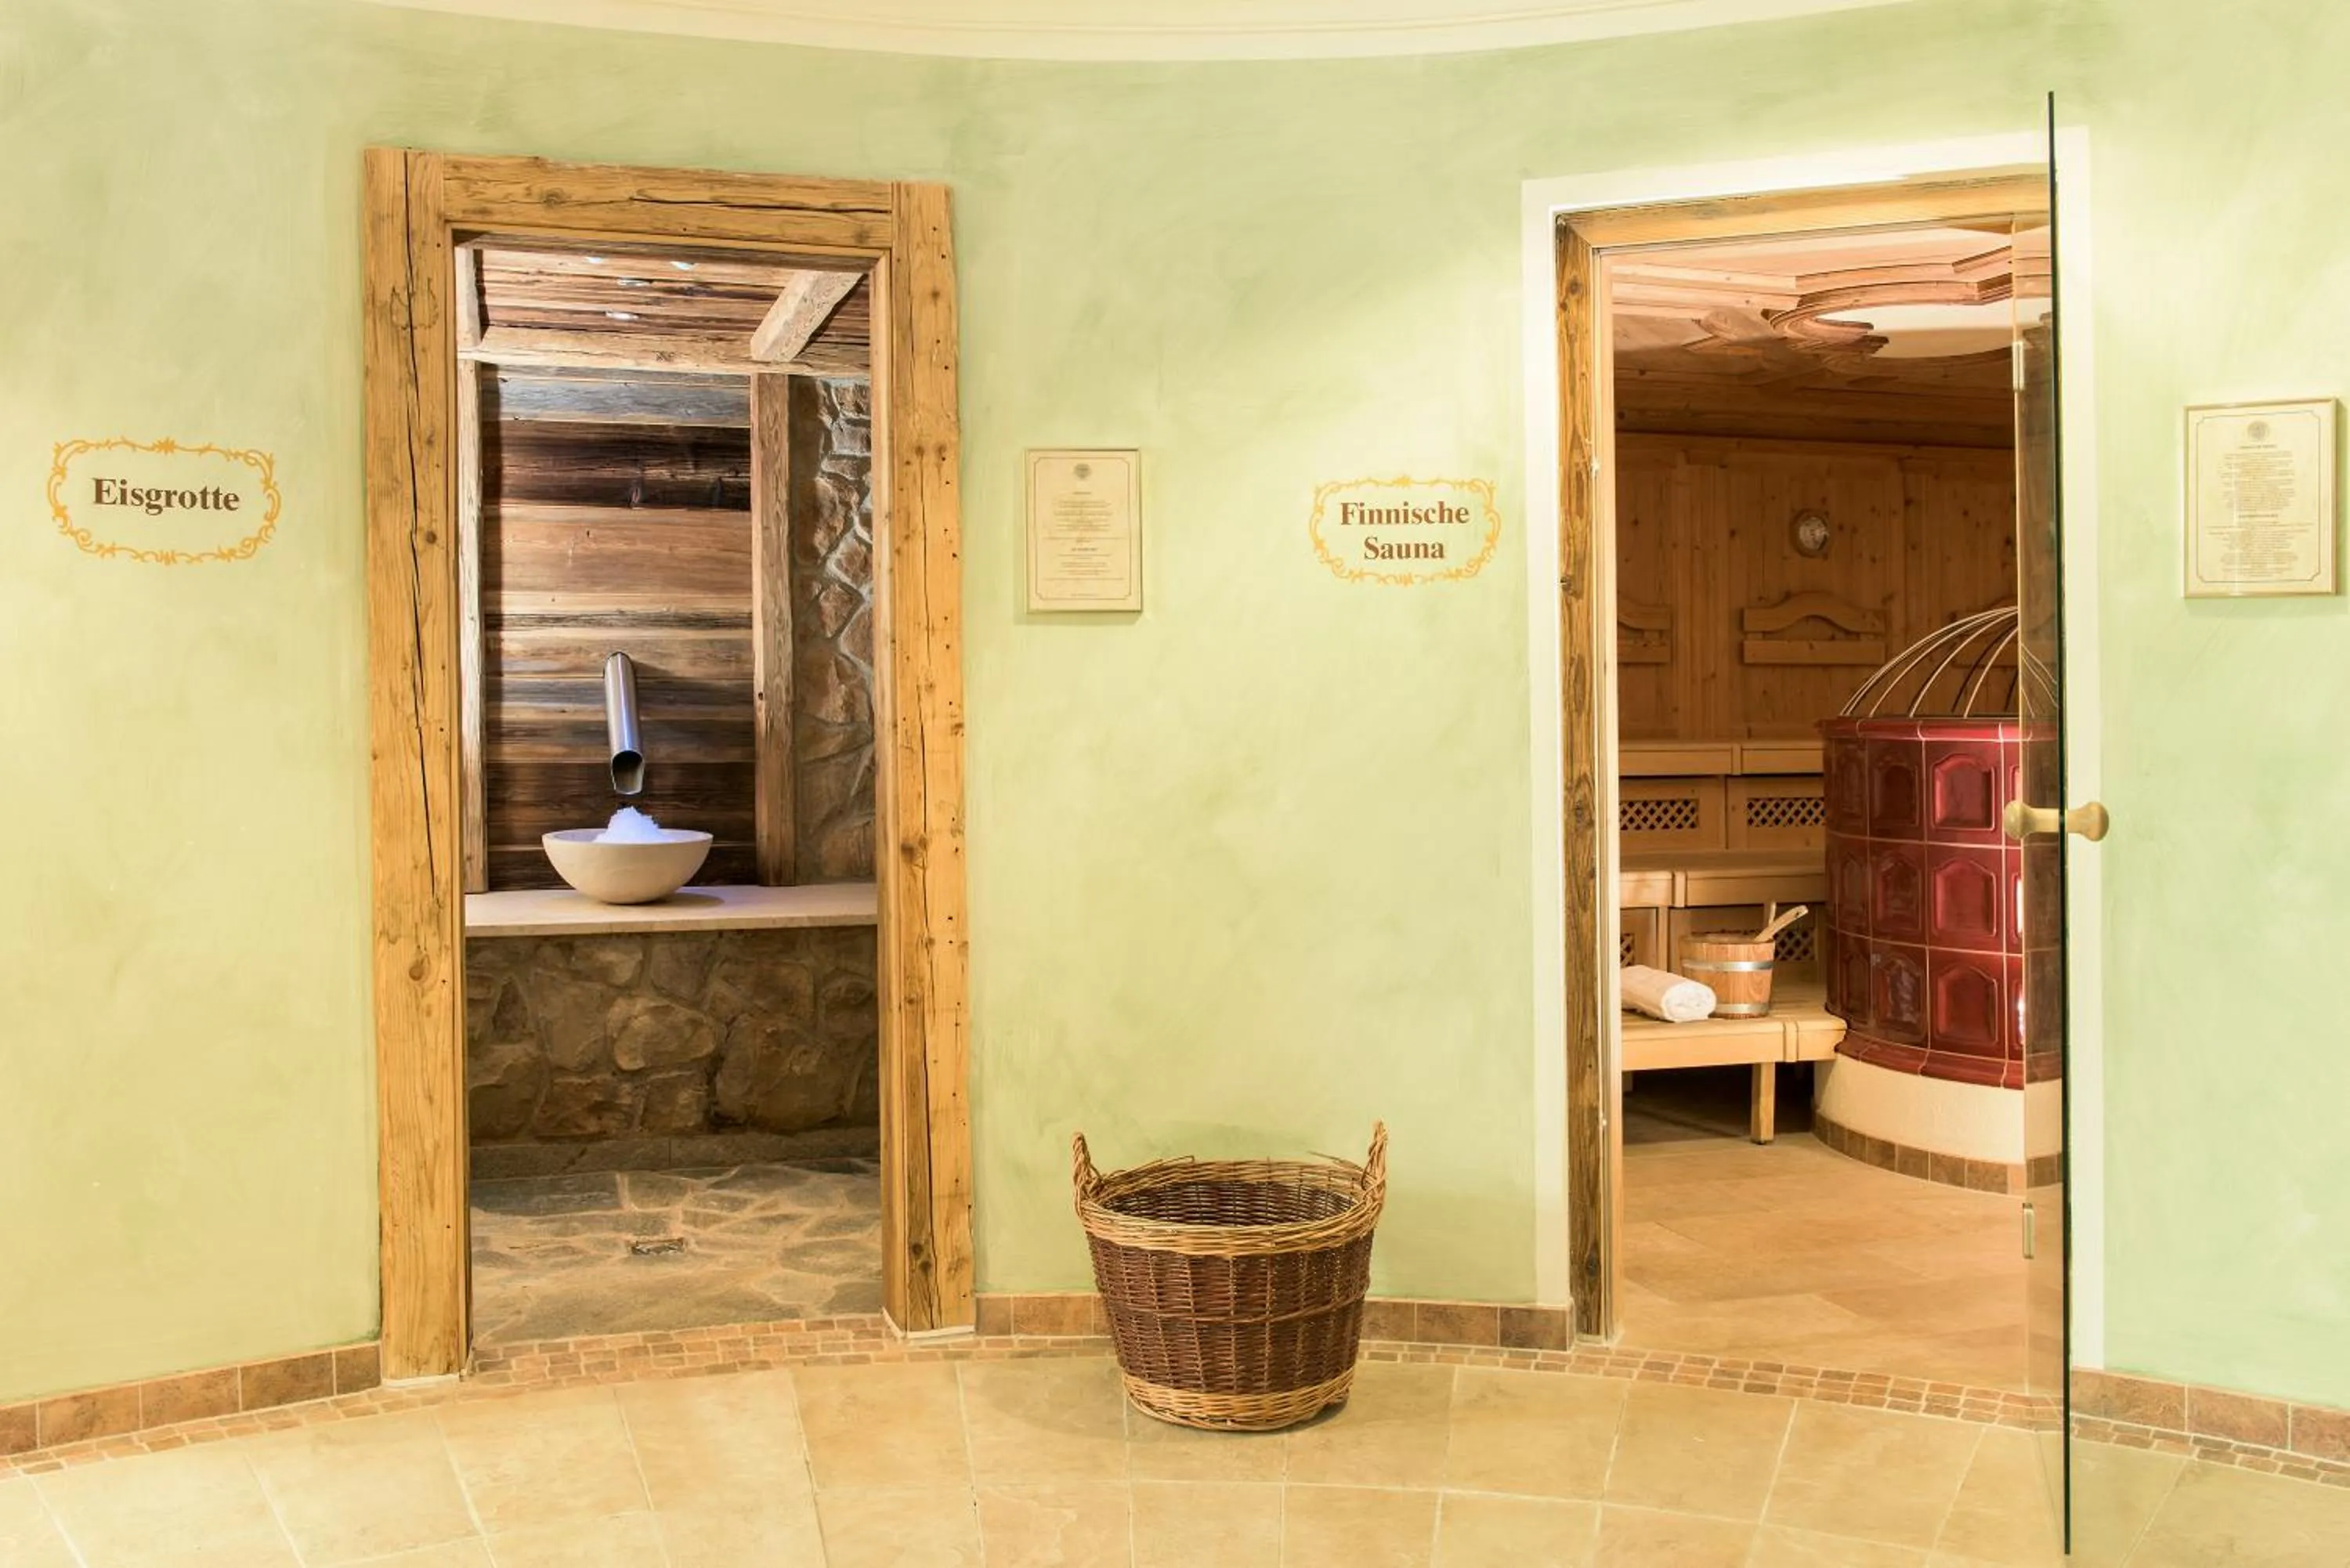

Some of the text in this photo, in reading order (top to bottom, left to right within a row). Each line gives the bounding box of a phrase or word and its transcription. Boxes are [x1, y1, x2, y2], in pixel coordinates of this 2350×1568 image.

[92, 477, 240, 515] Eisgrotte
[1340, 501, 1470, 526] Finnische
[1364, 536, 1444, 559] Sauna
